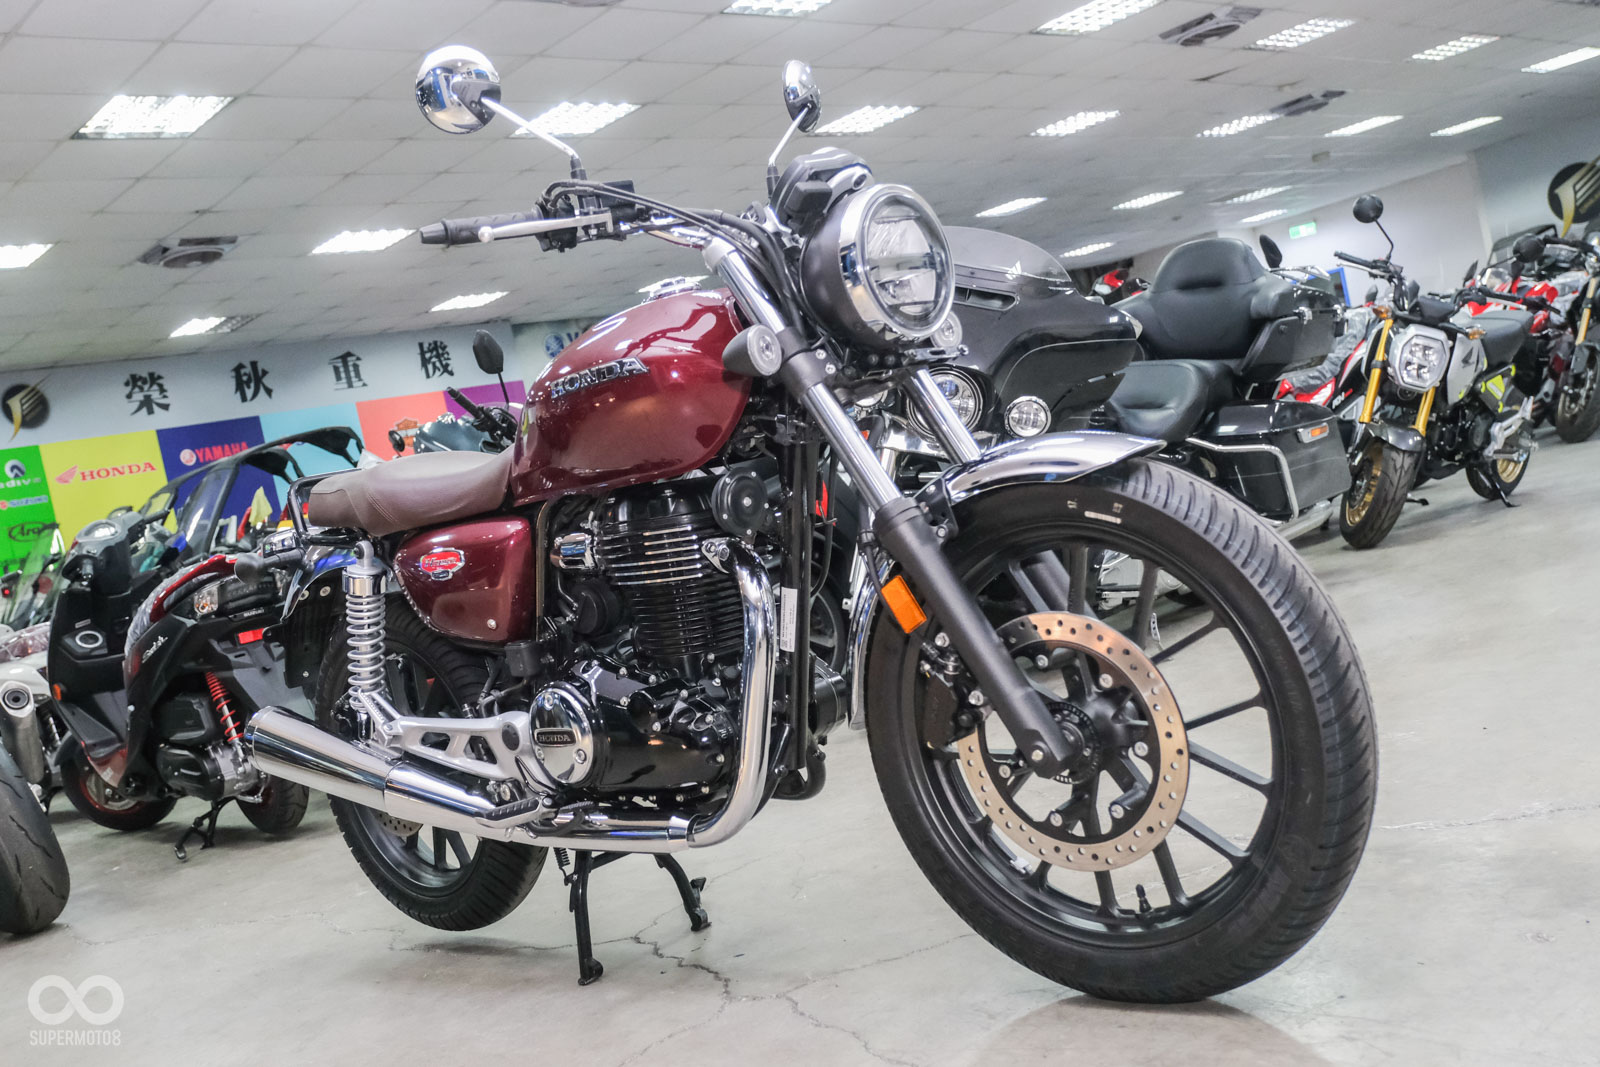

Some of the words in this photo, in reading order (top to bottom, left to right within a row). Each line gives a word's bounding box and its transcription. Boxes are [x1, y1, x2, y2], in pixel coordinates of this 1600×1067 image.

[124, 340, 455, 416] 榮秋重機
[550, 357, 649, 399] HONDA
[195, 441, 249, 463] YAMAHA
[80, 462, 157, 481] HONDA
[538, 734, 571, 742] HONDA
